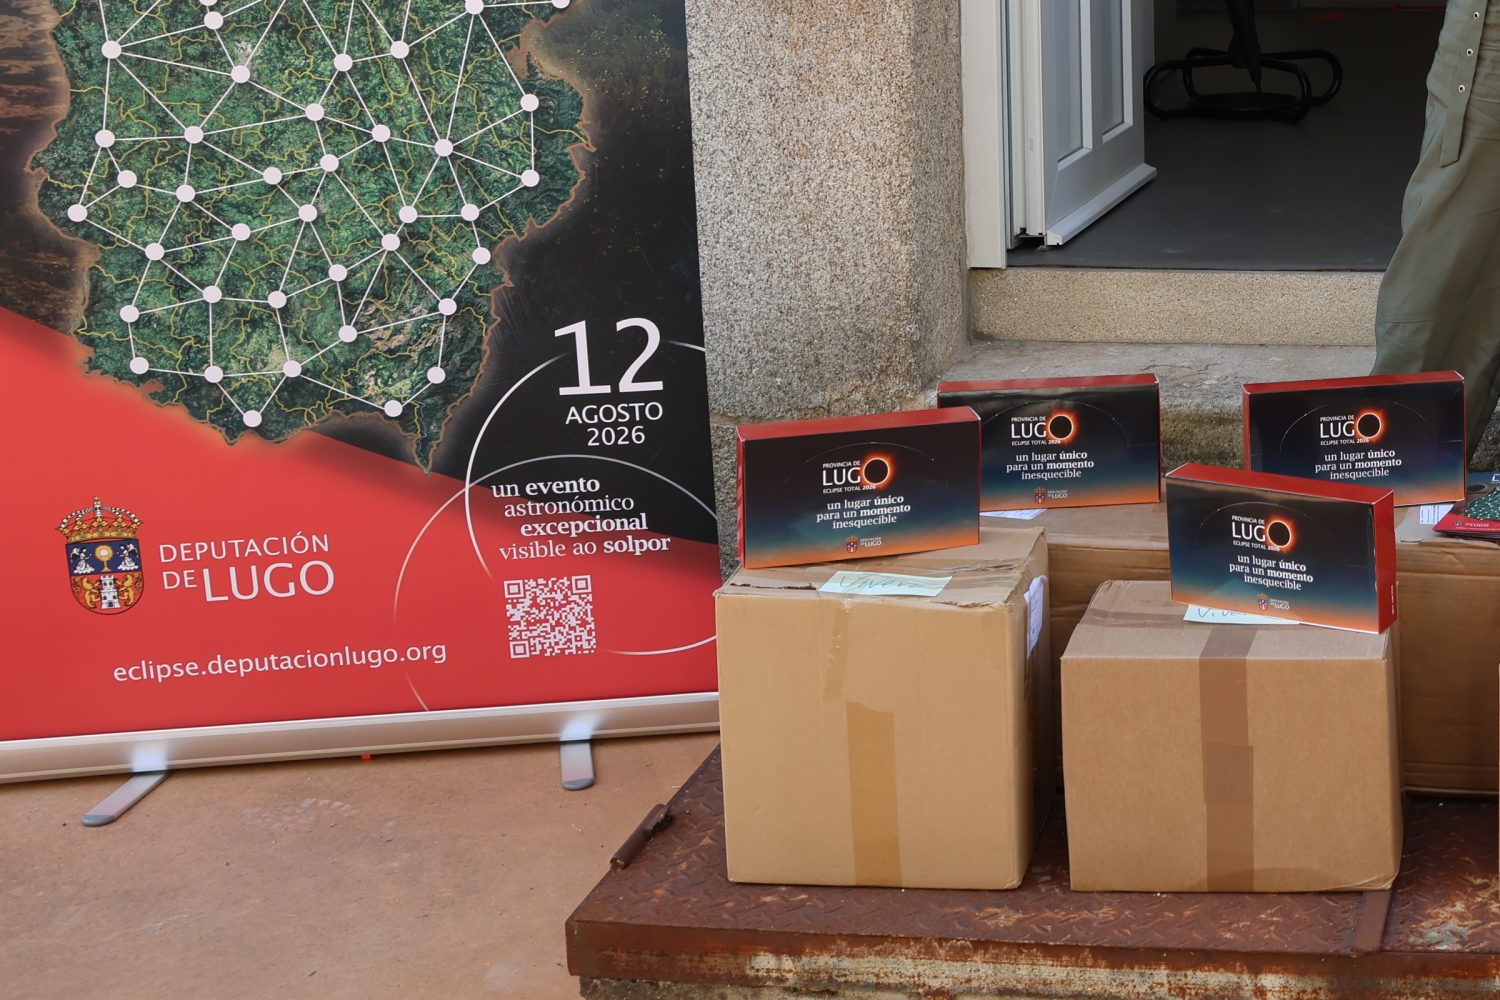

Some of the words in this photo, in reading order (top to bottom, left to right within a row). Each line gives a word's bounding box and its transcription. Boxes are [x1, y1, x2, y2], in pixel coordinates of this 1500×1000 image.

[554, 317, 663, 396] 12
[565, 402, 663, 424] AGOSTO
[1011, 414, 1074, 441] LUGO
[1320, 412, 1381, 439] LUGO
[587, 426, 645, 446] 2026
[1032, 452, 1056, 462] lugar
[1059, 450, 1087, 460] único
[1340, 451, 1365, 462] lugar
[1368, 449, 1395, 459] único
[823, 458, 891, 486] LUGO
[1006, 464, 1028, 473] para
[1046, 460, 1094, 469] momento
[1021, 469, 1081, 480] inesquecible
[1315, 464, 1336, 473] para
[1355, 459, 1402, 469] momento
[1330, 468, 1389, 480] inesquecible
[491, 483, 520, 498] un
[525, 477, 600, 495] evento
[504, 496, 634, 517] astronómico
[844, 499, 871, 510] lugar
[875, 495, 904, 505] único
[816, 512, 839, 523] para
[860, 504, 911, 516] momento
[833, 515, 897, 529] inesquecible
[520, 513, 648, 537] excepcional
[1232, 520, 1291, 548] LUGO
[159, 531, 329, 563] DEPUTACIÓN
[499, 540, 566, 560] visible
[573, 541, 597, 555] ao
[603, 536, 670, 555] solpor
[1229, 563, 1250, 573] para
[1252, 567, 1264, 575] un
[1267, 569, 1313, 582] momento
[1238, 555, 1250, 563] un
[1252, 555, 1276, 568] lugar
[1279, 559, 1306, 572] único
[162, 569, 198, 590] DE
[202, 560, 335, 602] LUGO
[1244, 574, 1302, 590] inesquecible
[113, 644, 447, 683] eclipse.deputacionlugo.org
